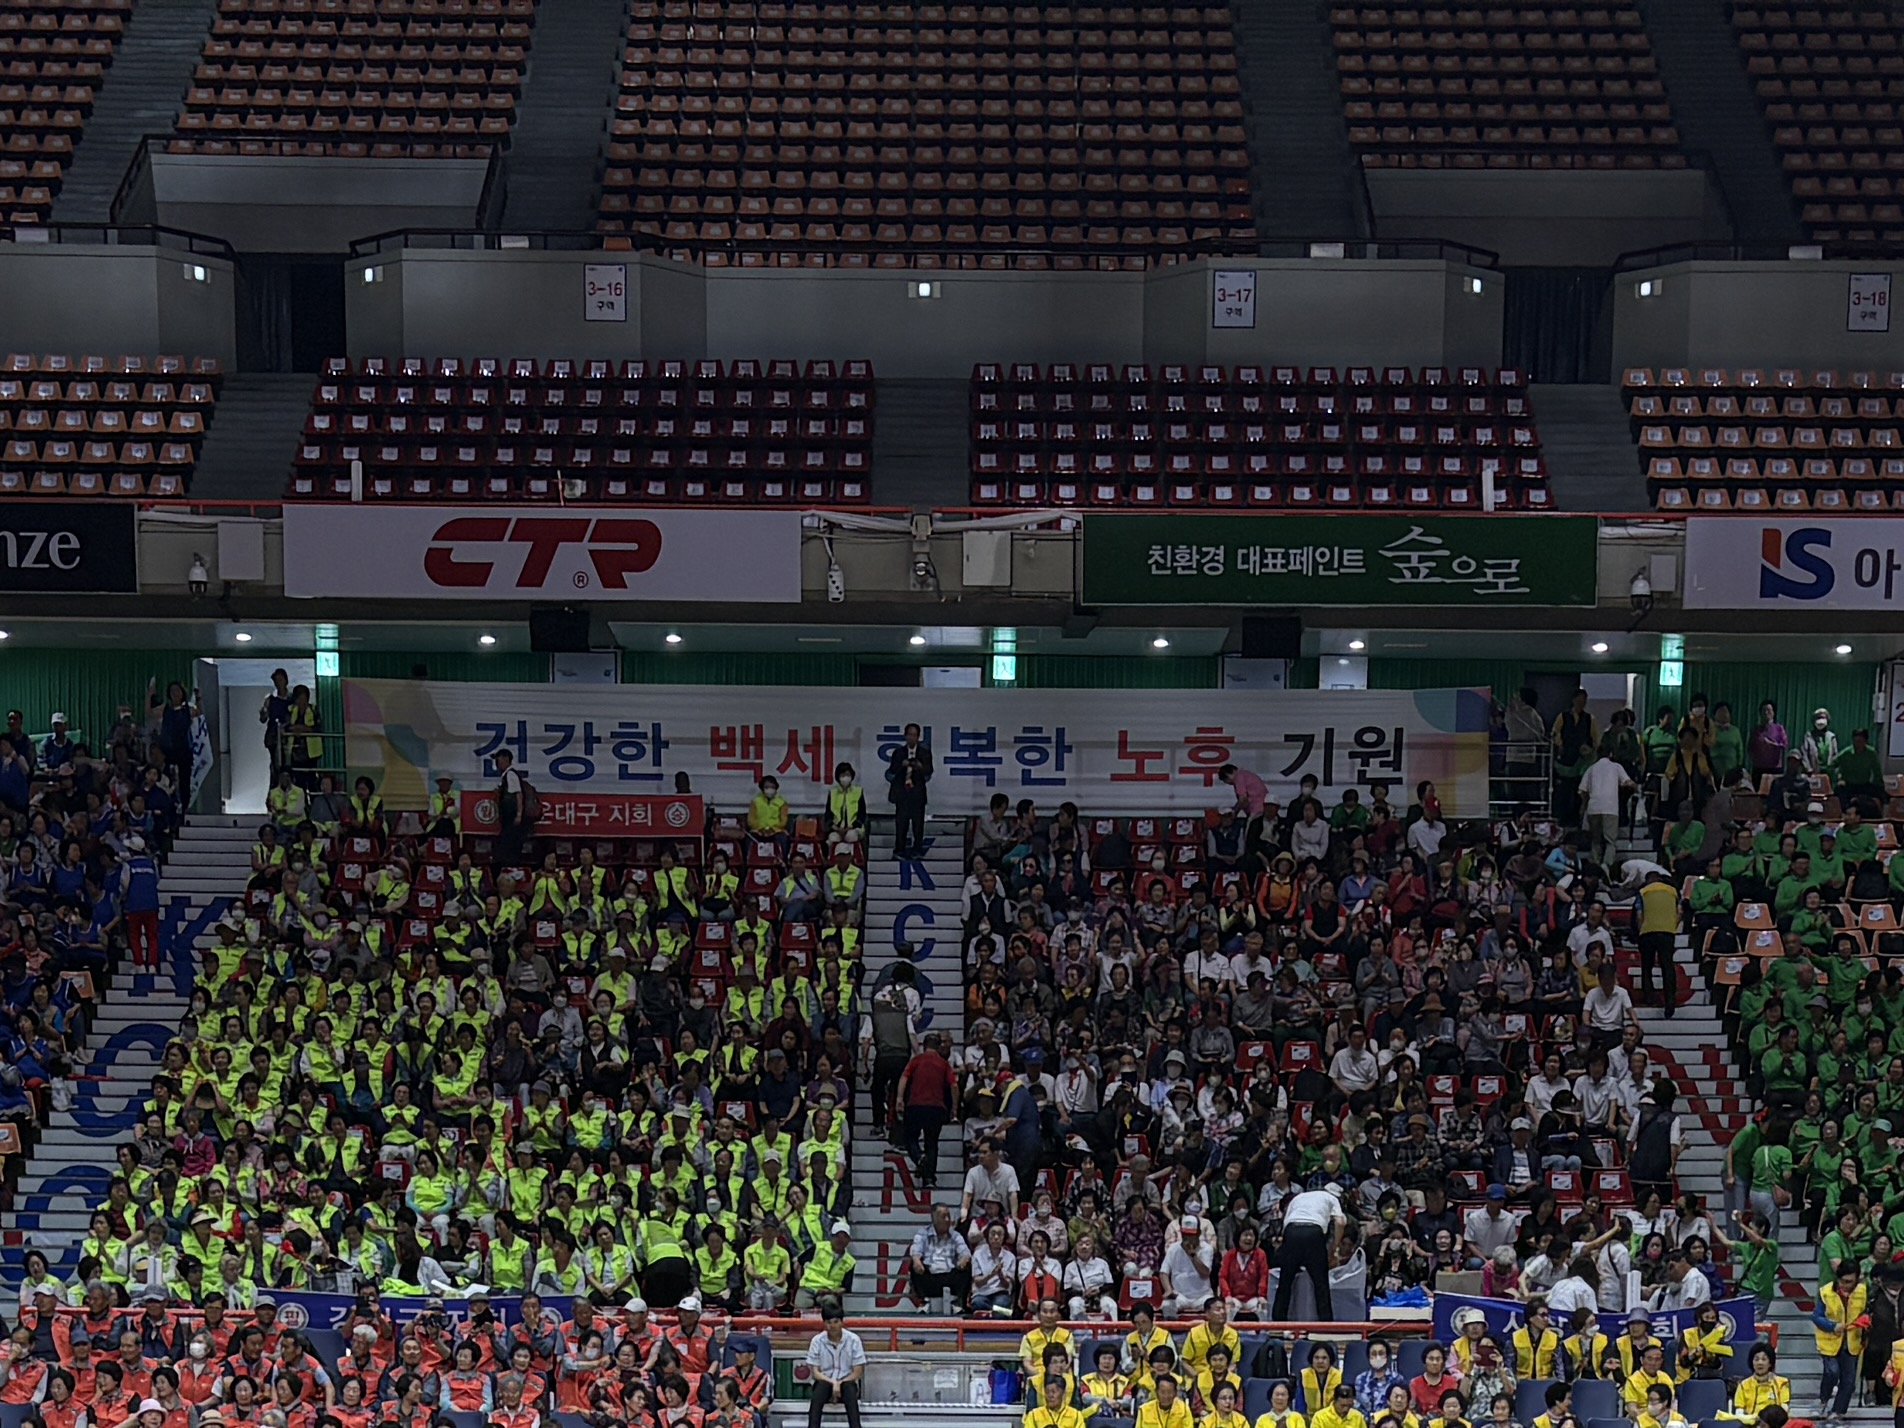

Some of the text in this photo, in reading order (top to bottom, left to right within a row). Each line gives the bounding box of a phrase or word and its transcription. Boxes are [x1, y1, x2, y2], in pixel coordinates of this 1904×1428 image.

[587, 281, 623, 297] 3-16
[1217, 287, 1252, 304] 3-17
[1852, 291, 1887, 307] 3-18
[1147, 524, 1531, 596] 친환경 대표페인트 숲으로
[473, 718, 670, 782] 건강한
[708, 723, 835, 785] 백세
[1109, 726, 1236, 787] 노후
[1281, 726, 1405, 788] 기원
[608, 803, 653, 827] 지회
